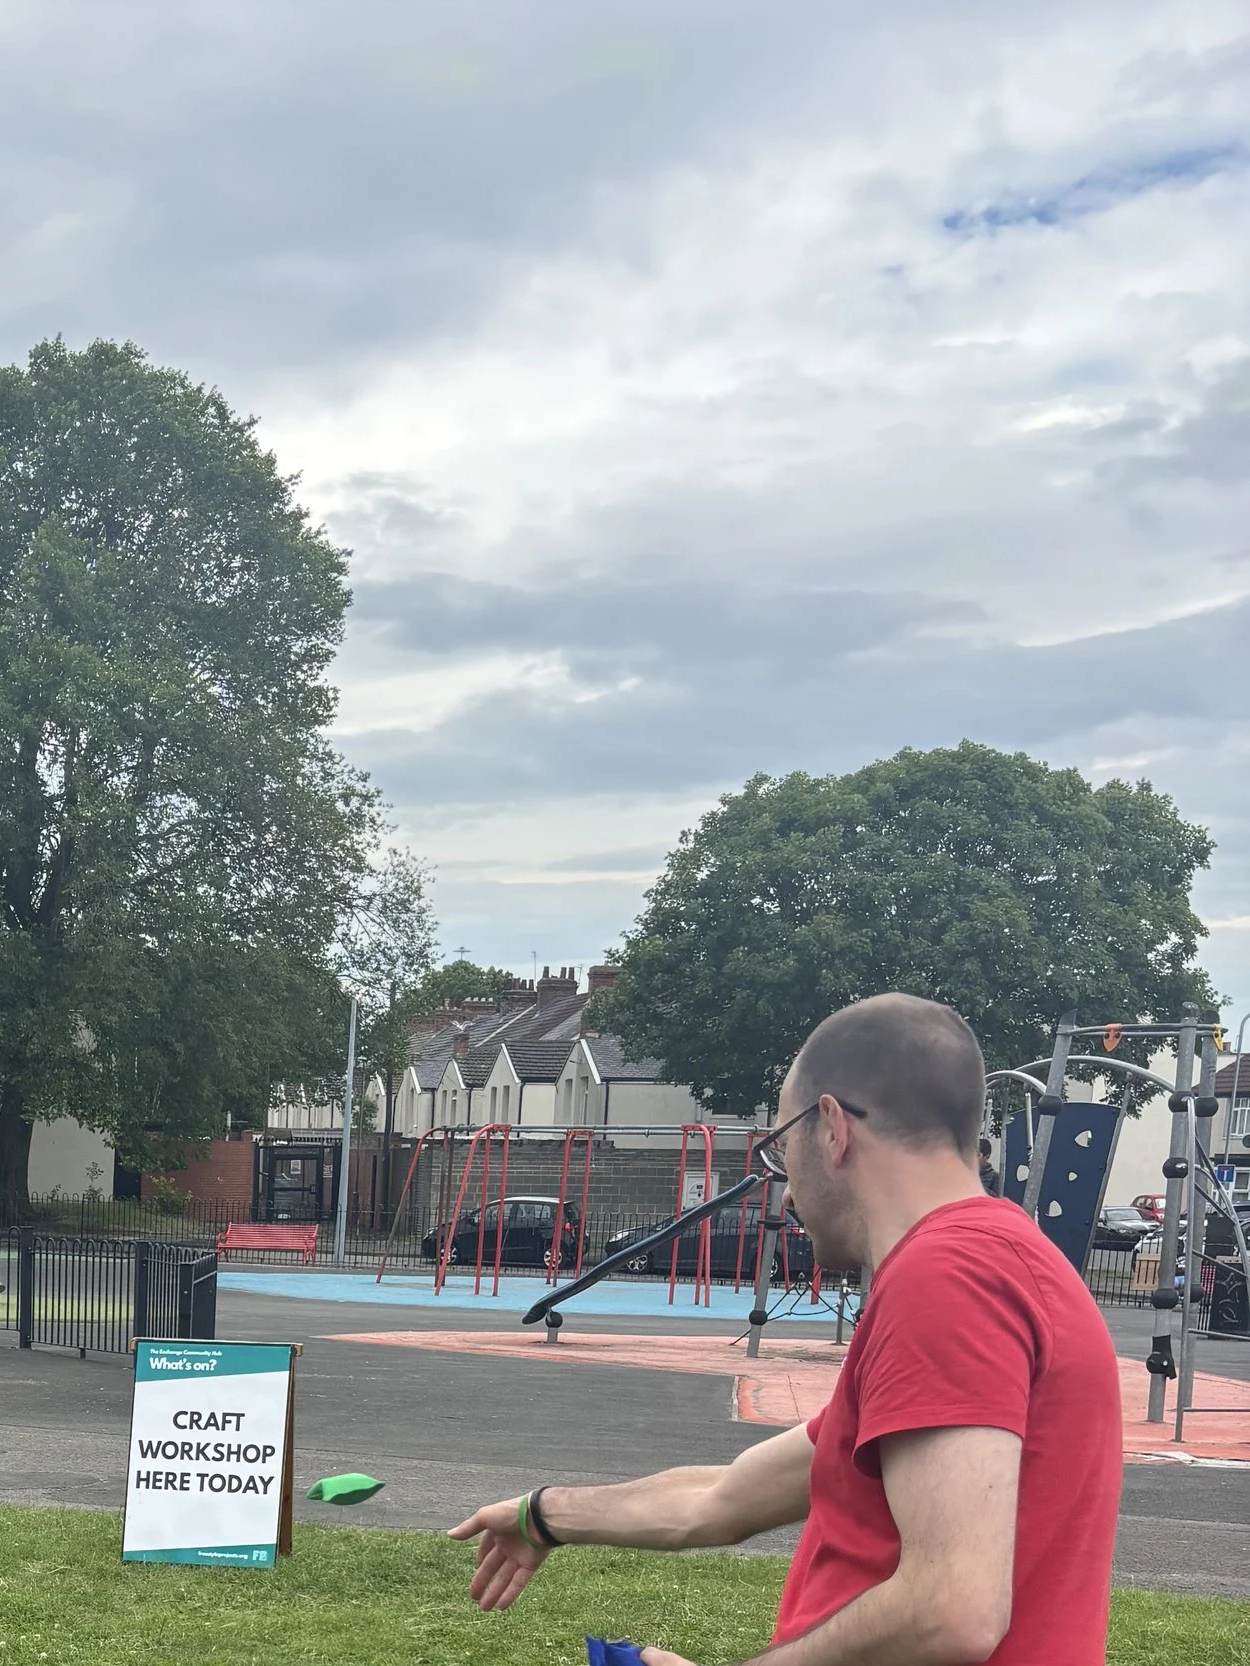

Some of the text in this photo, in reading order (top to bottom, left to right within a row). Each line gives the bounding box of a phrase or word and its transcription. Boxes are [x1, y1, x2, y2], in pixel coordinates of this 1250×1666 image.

[183, 1349, 211, 1357] Community
[193, 1359, 217, 1372] on?
[172, 1410, 246, 1432] CRAFT
[138, 1439, 276, 1464] WORKSHOP
[135, 1470, 275, 1495] HERE TODAY
